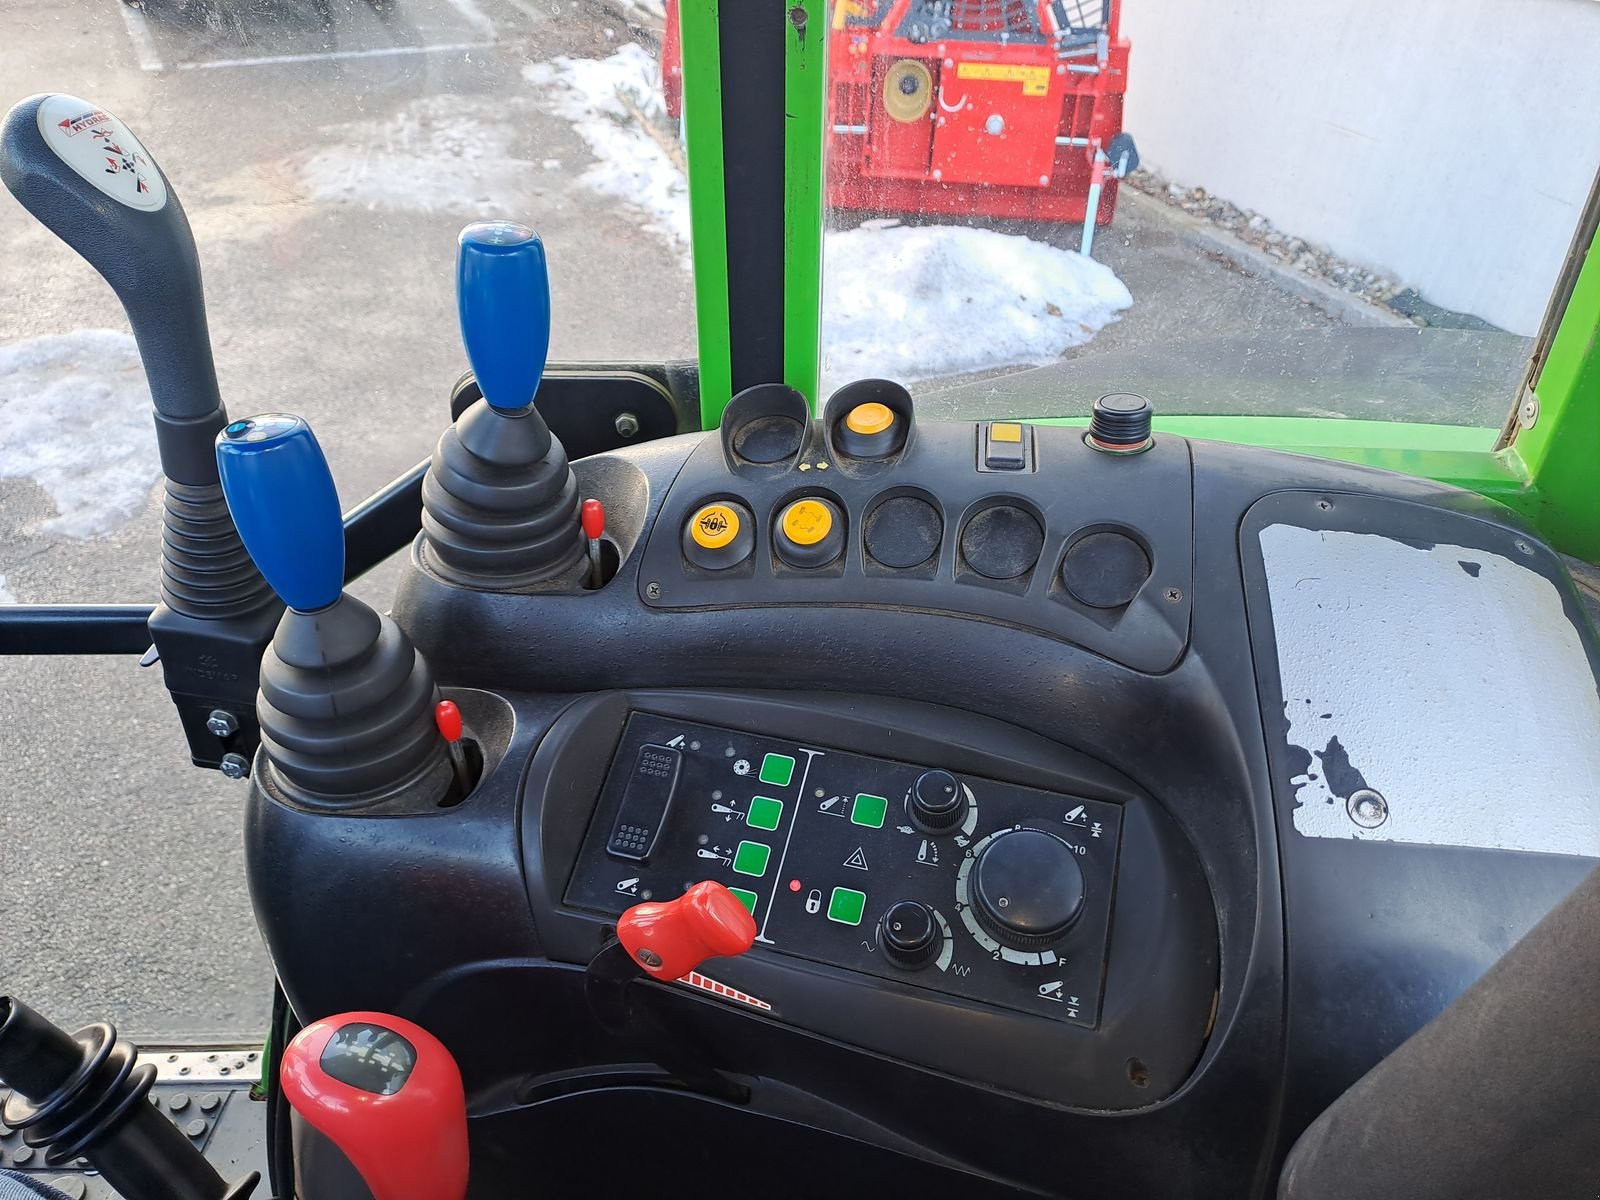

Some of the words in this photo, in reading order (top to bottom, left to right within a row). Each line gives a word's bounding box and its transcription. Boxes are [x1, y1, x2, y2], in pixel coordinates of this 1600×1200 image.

[965, 849, 973, 858] 6
[1073, 845, 1086, 855] 10
[954, 902, 962, 912] 4
[992, 951, 1001, 961] 2
[1058, 957, 1067, 967] F
